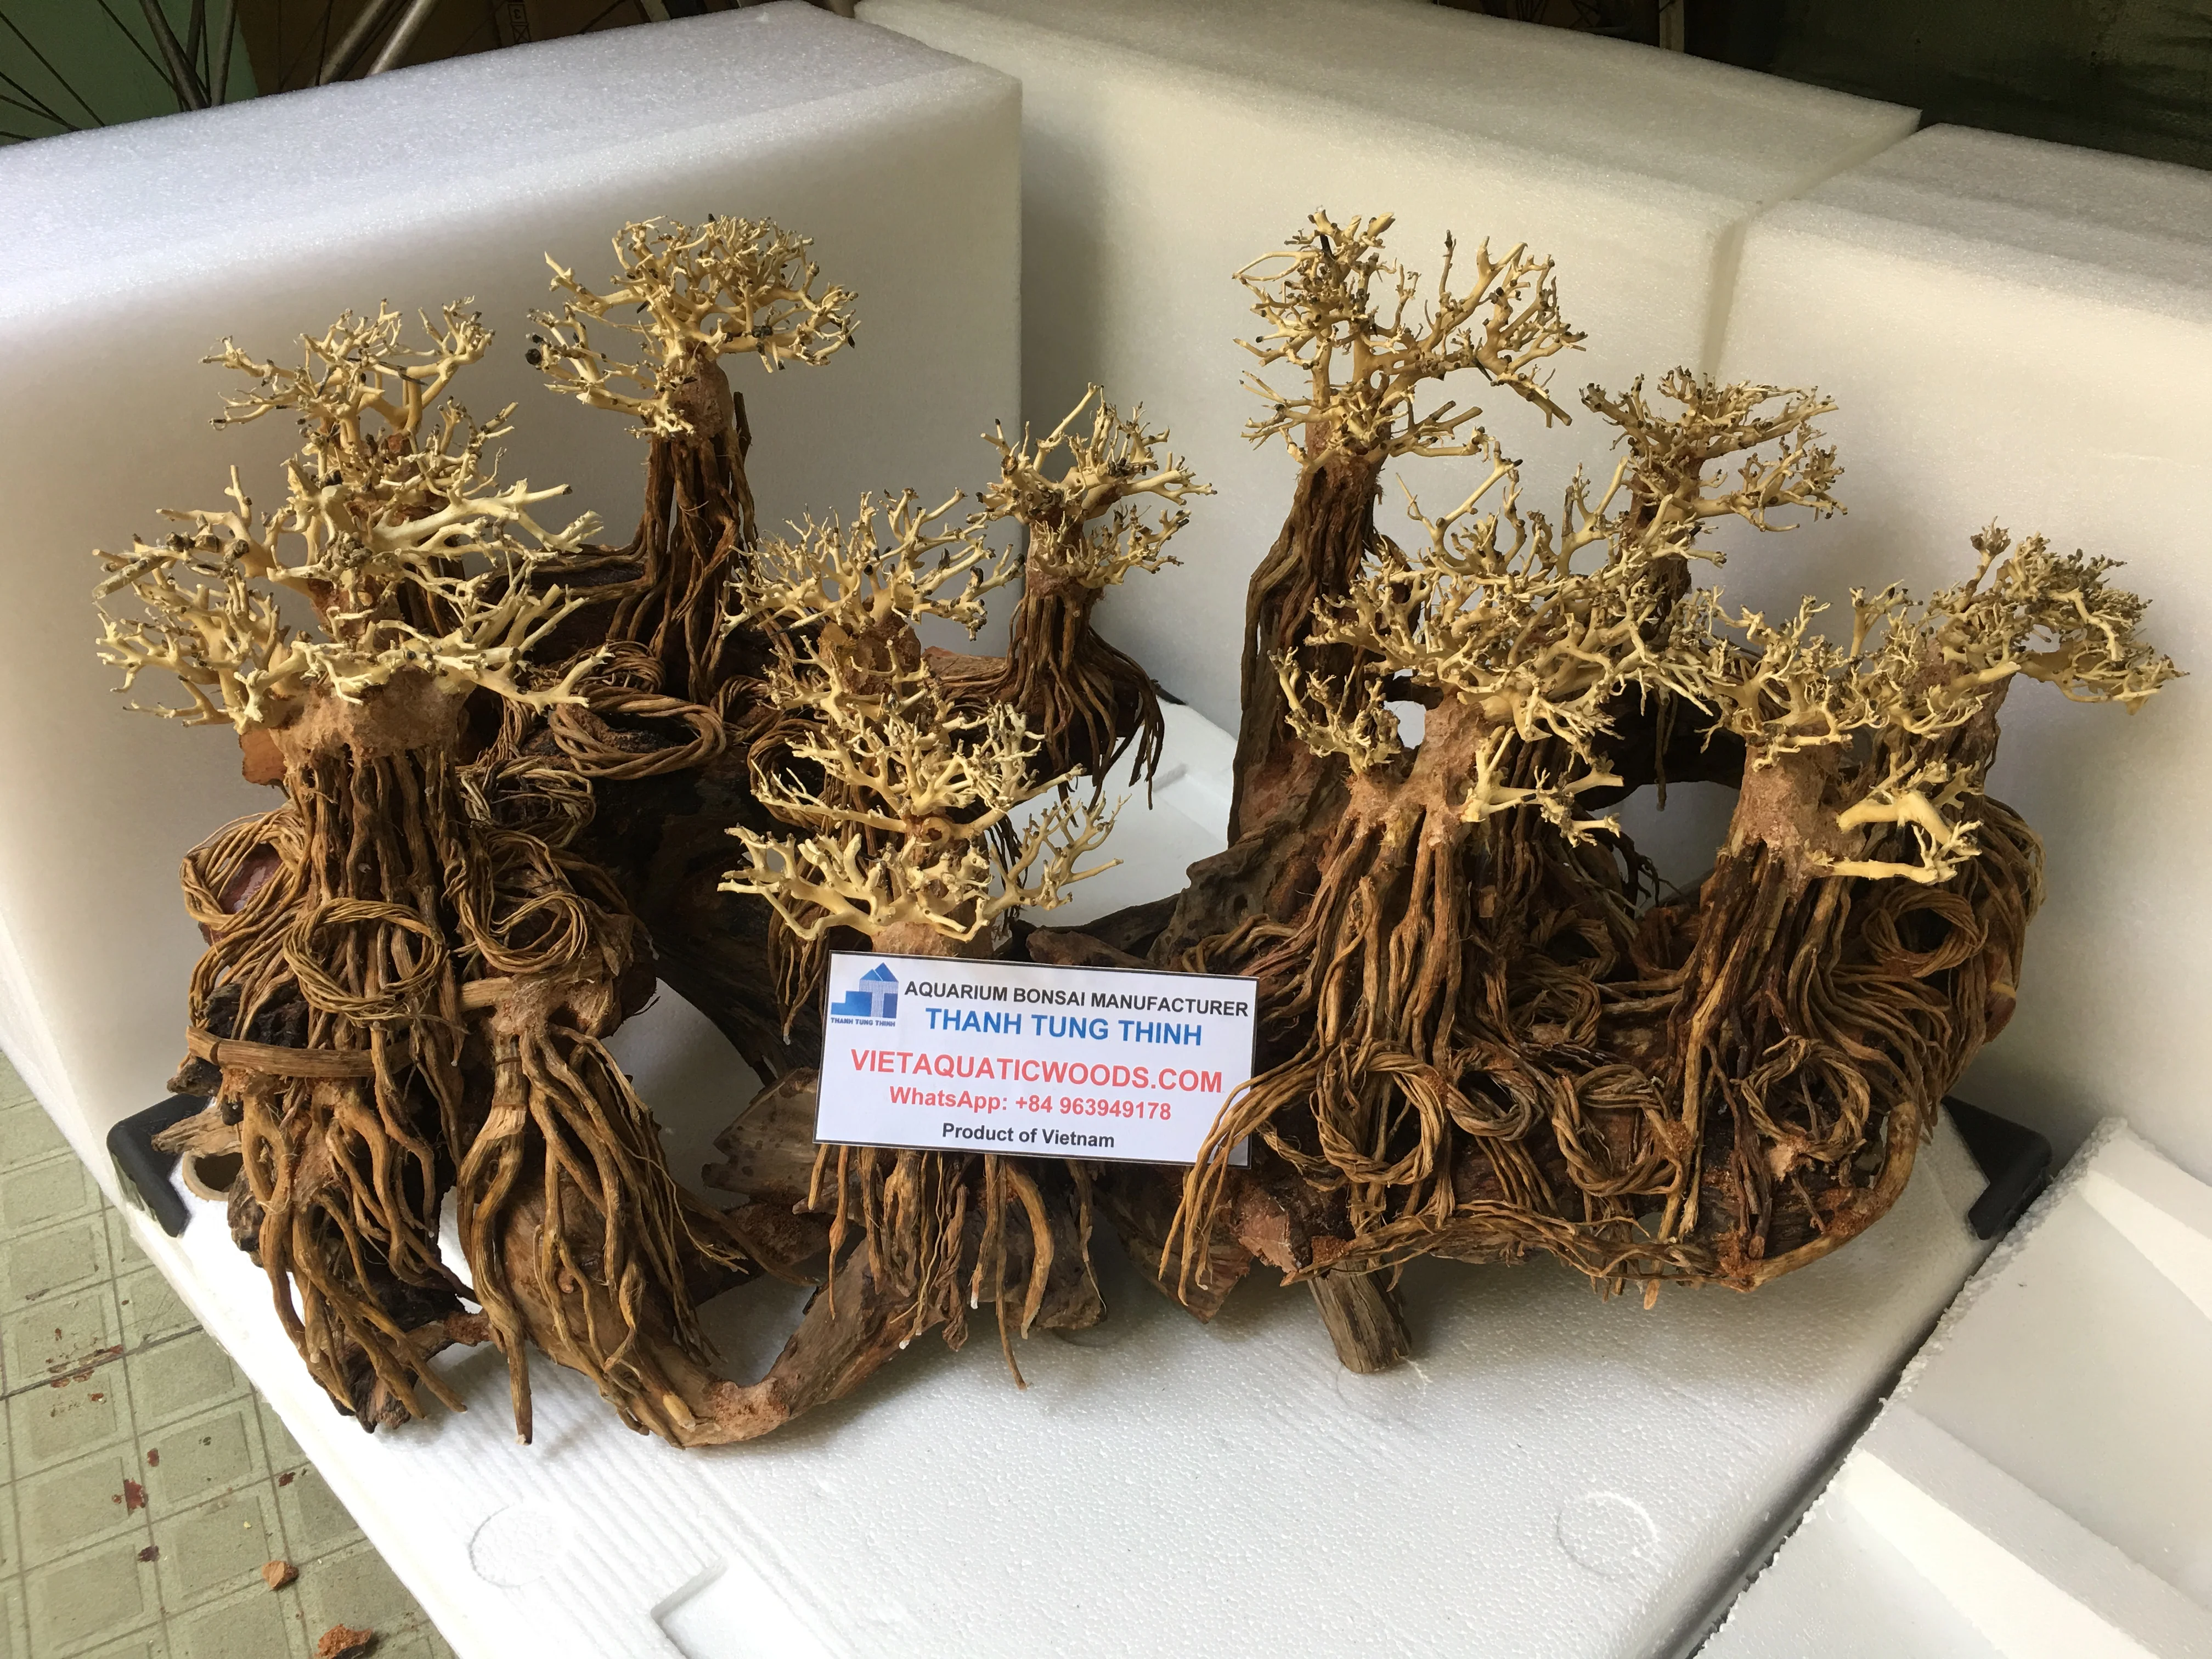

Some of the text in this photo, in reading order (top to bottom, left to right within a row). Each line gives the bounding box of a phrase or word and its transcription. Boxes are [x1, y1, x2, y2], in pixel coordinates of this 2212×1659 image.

[904, 981, 1249, 1017] AQUARIUM BONSAI MANUFACTURER
[925, 1007, 1202, 1046] THANH TUNG THINH
[850, 1048, 1222, 1093] VIETAQUATICWOODS.COM
[889, 1086, 1171, 1120] WhatsApp: +84 963949178
[942, 1122, 1115, 1148] Product of Vietnam
